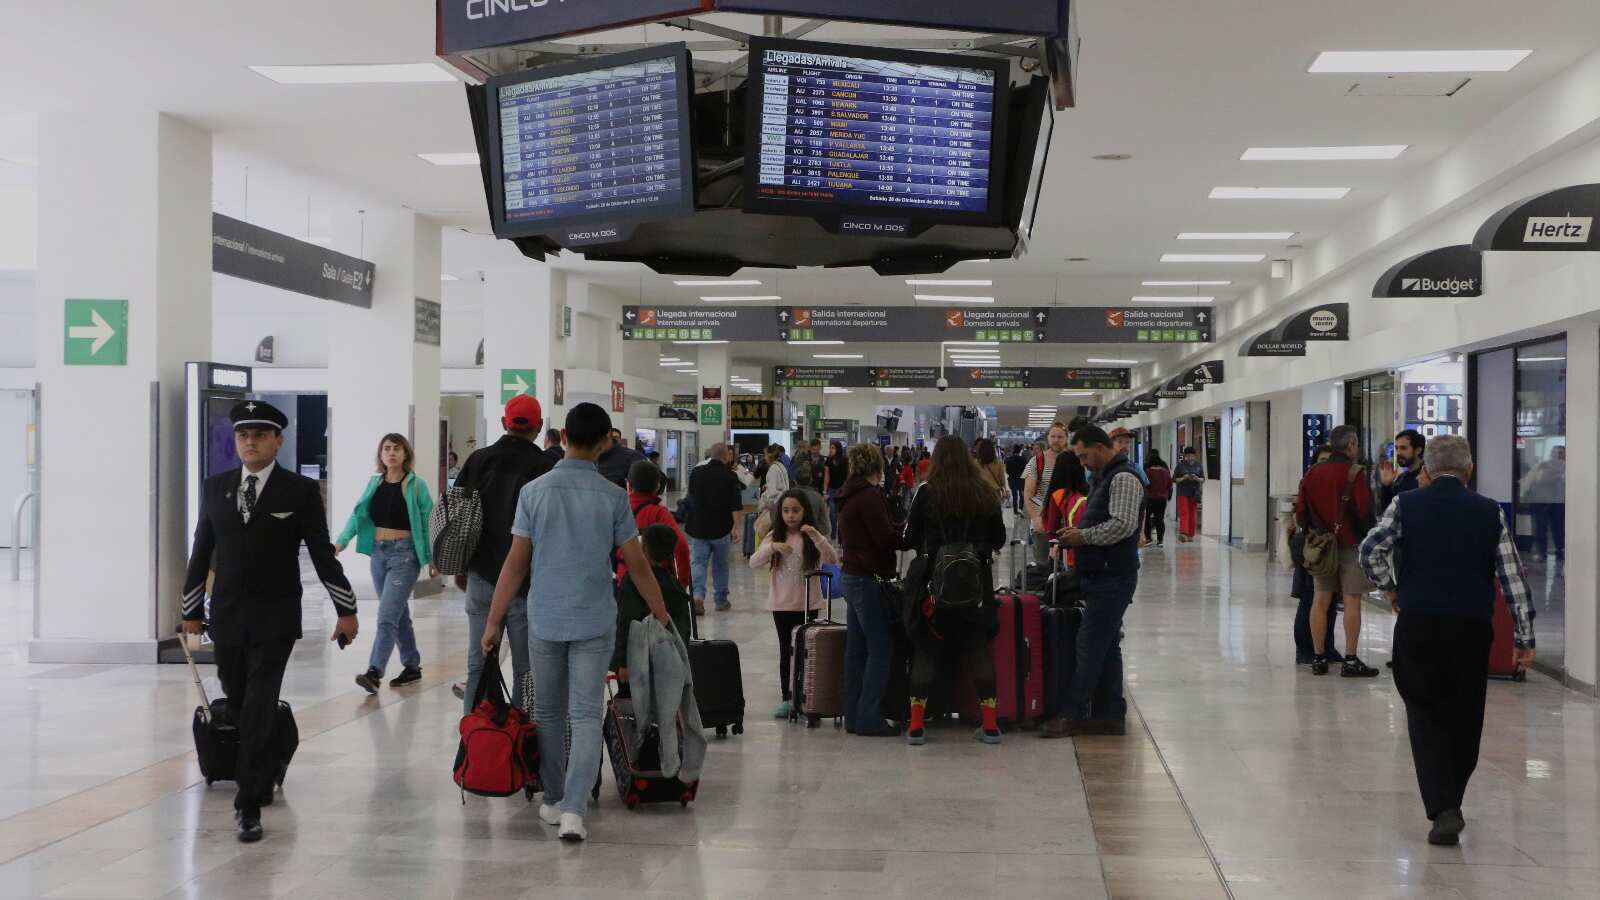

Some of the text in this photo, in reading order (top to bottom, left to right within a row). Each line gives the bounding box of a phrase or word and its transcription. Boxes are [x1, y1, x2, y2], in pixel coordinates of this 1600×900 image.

[844, 222, 871, 230] CINCO
[1531, 222, 1582, 238] Hertz
[322, 262, 337, 281] Sala
[352, 271, 364, 290] E2
[1422, 277, 1474, 294] Budget
[657, 310, 737, 322] Llegada internacional
[812, 310, 886, 318] Salida internacional
[964, 311, 1030, 322] Llegada nacional
[1124, 310, 1184, 319] Salida nacional
[852, 320, 888, 328] departures
[1158, 320, 1193, 328] departures
